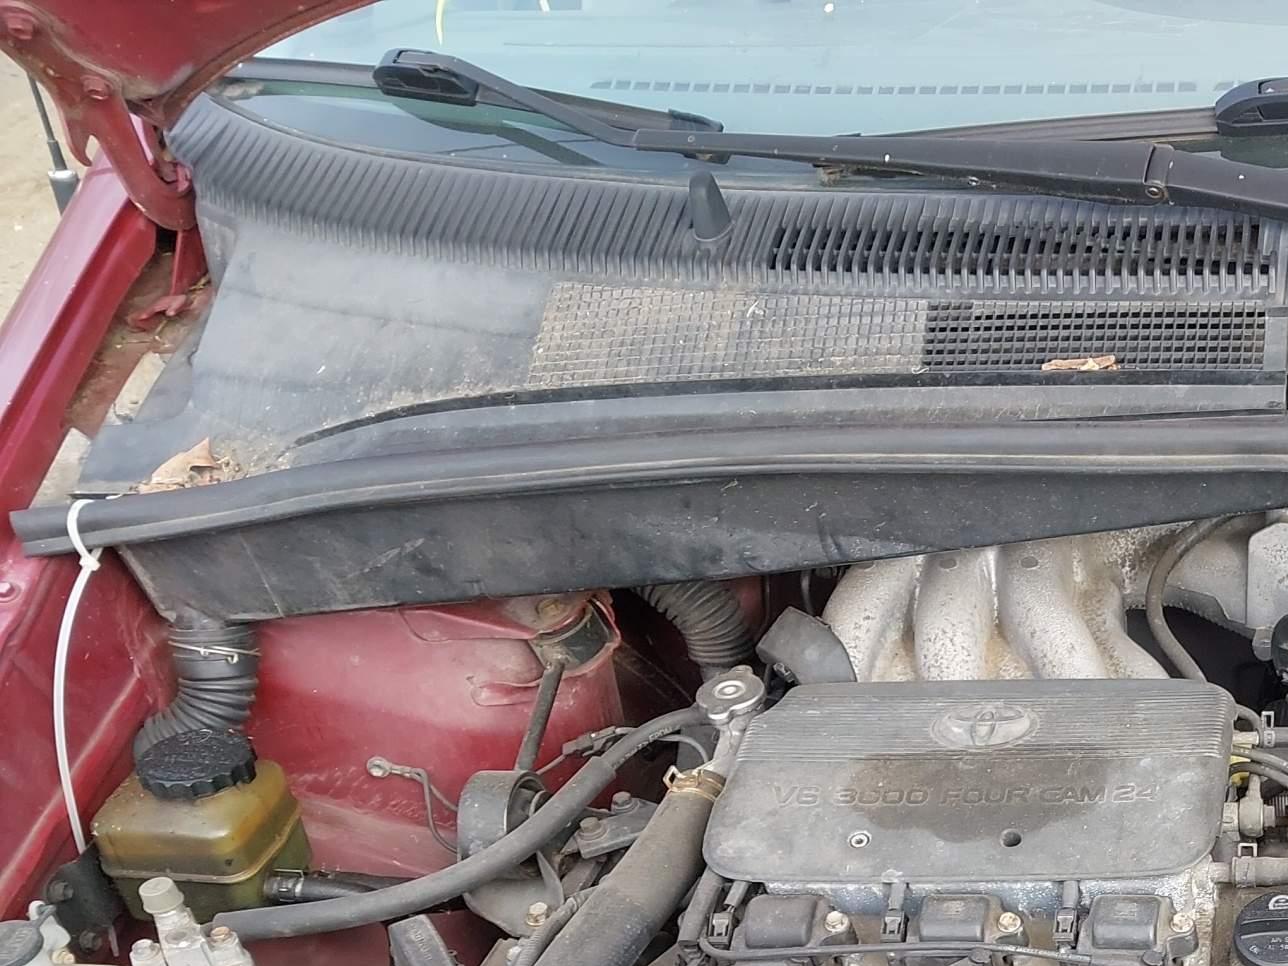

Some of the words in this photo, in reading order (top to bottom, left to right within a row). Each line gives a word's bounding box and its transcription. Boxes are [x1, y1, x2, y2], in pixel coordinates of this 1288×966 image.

[773, 785, 820, 808] V6
[833, 787, 929, 808] 3000
[939, 787, 1030, 806] FOUR
[1039, 785, 1107, 805] CAM
[1111, 783, 1160, 804] 24
